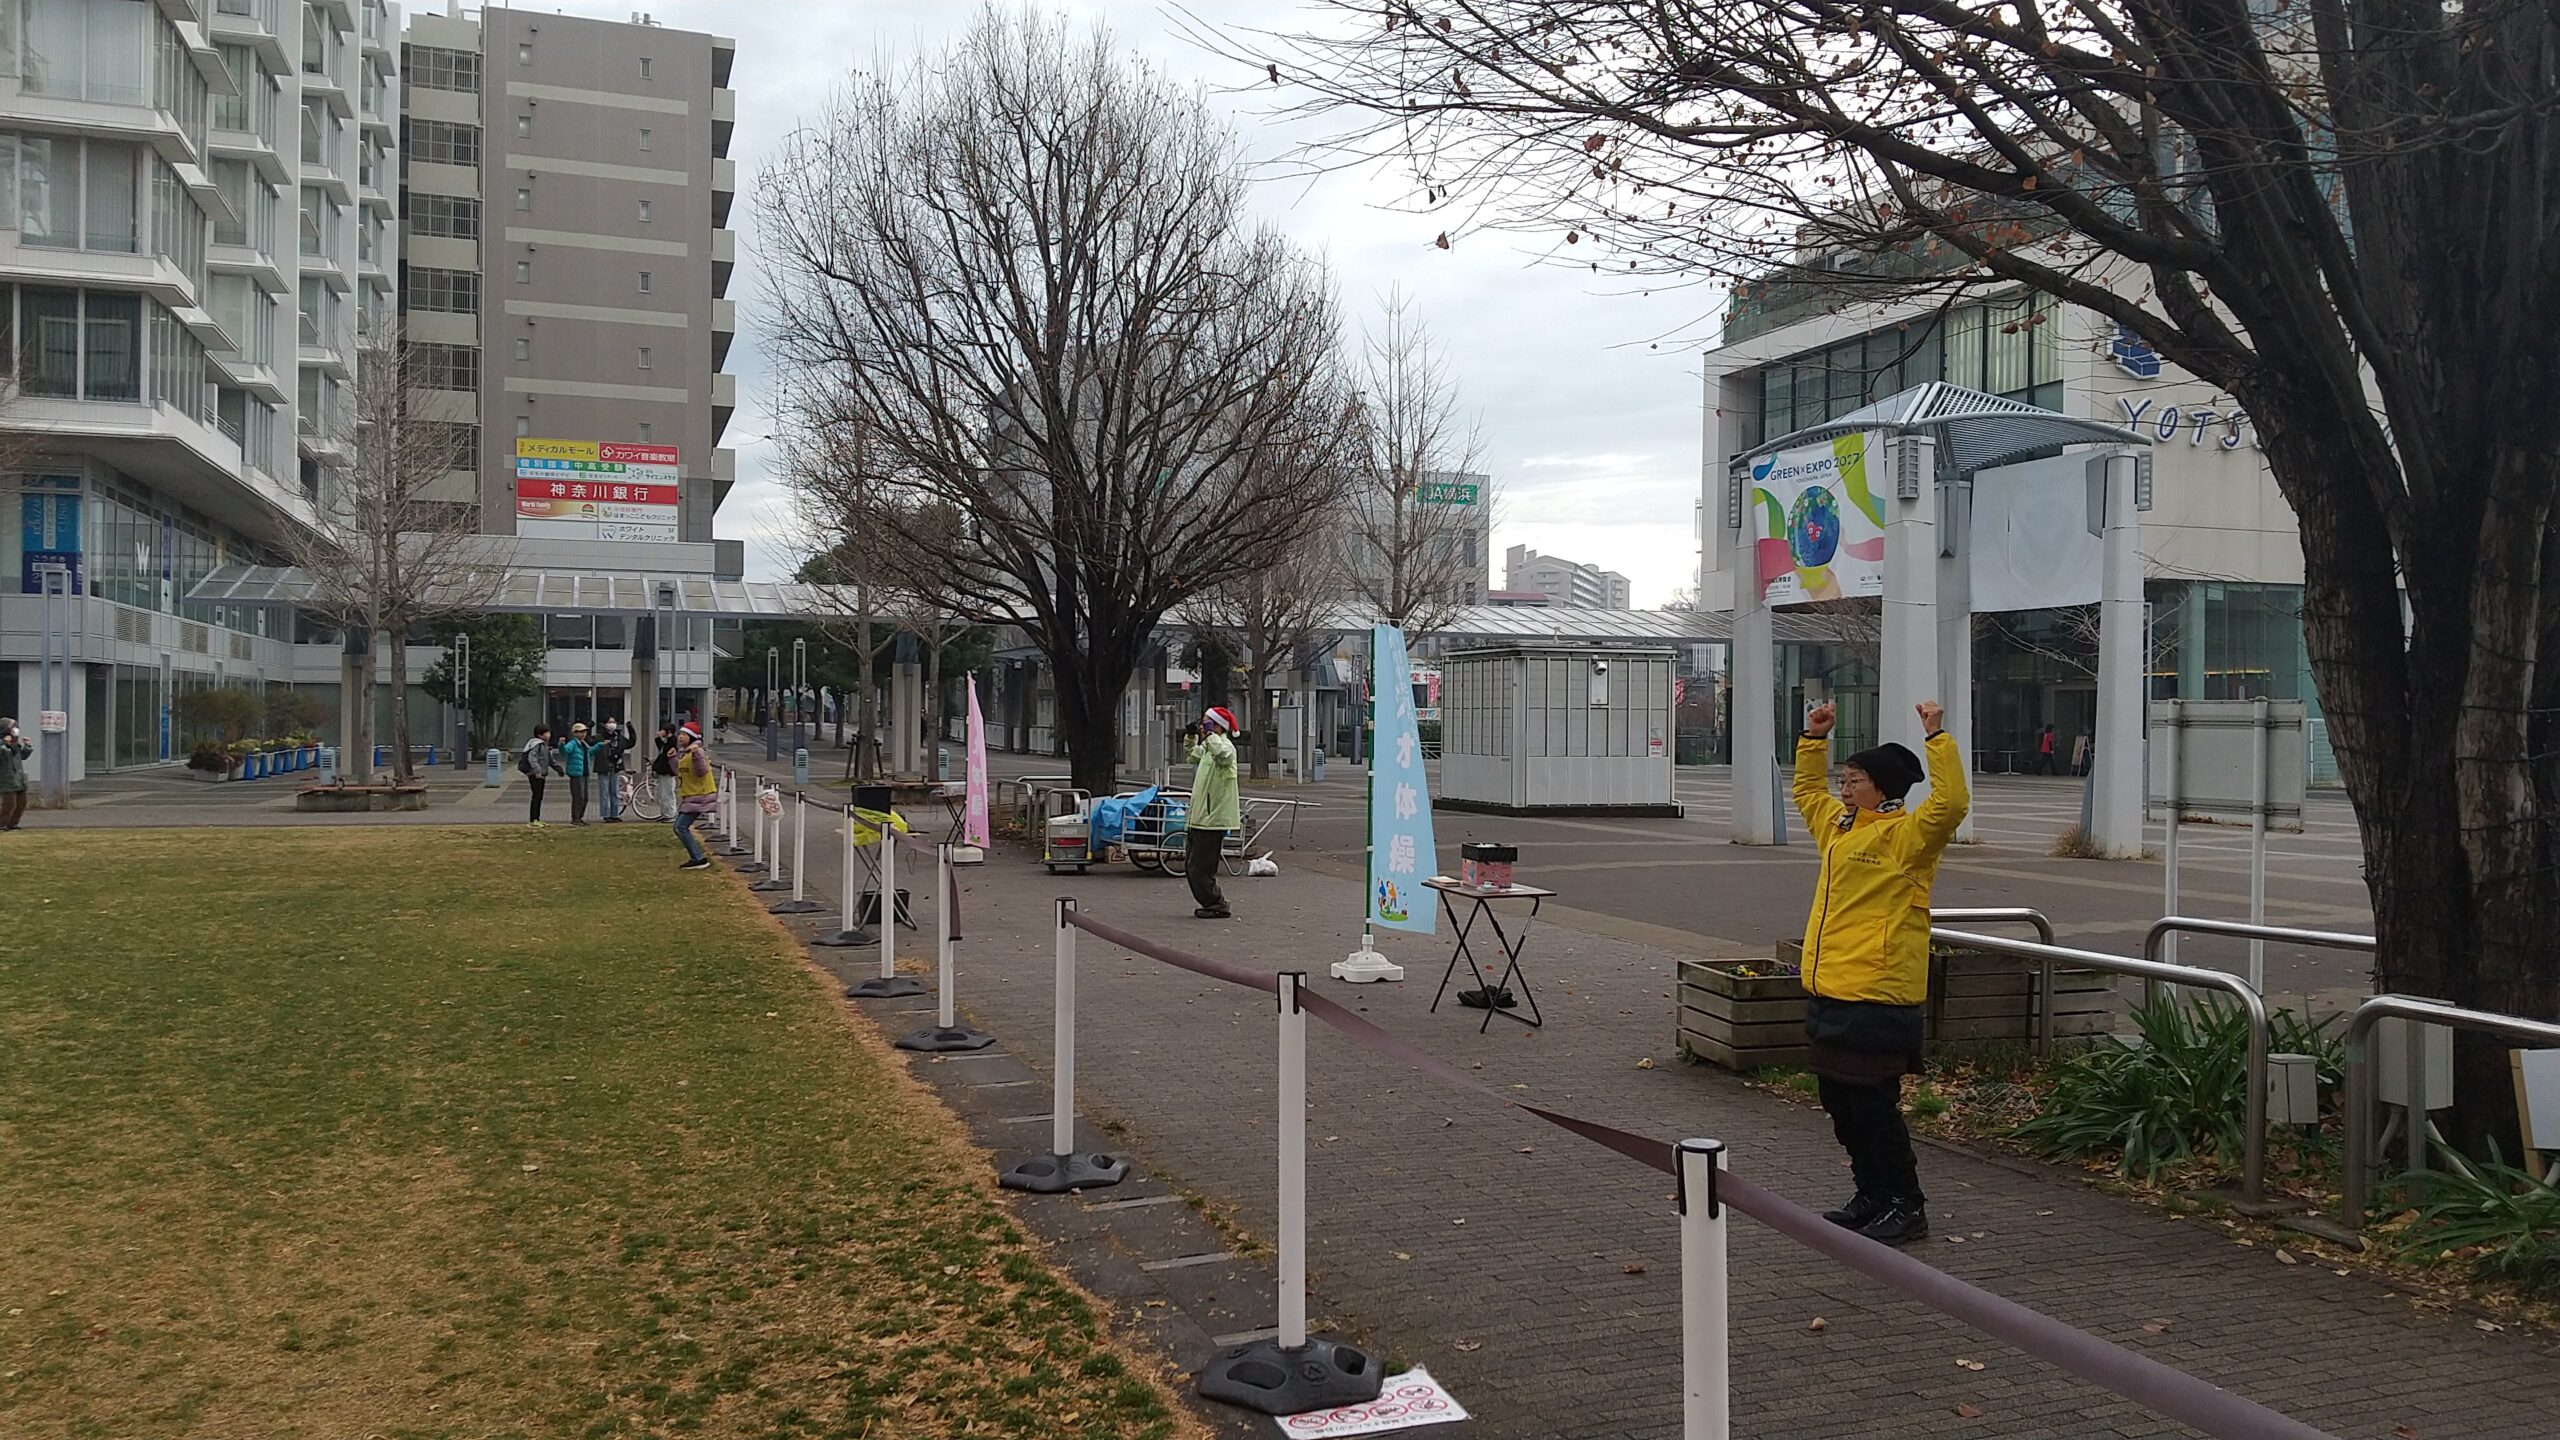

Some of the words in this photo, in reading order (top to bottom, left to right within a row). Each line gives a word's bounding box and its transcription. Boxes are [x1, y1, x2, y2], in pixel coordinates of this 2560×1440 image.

[2117, 396, 2263, 450] YOTS
[528, 444, 594, 455] メディカルモール
[615, 451, 676, 462] カワイ音楽教室
[1834, 452, 1860, 469] 2027
[550, 482, 649, 501] 神奈川銀行
[618, 534, 676, 542] デンタルクリニック
